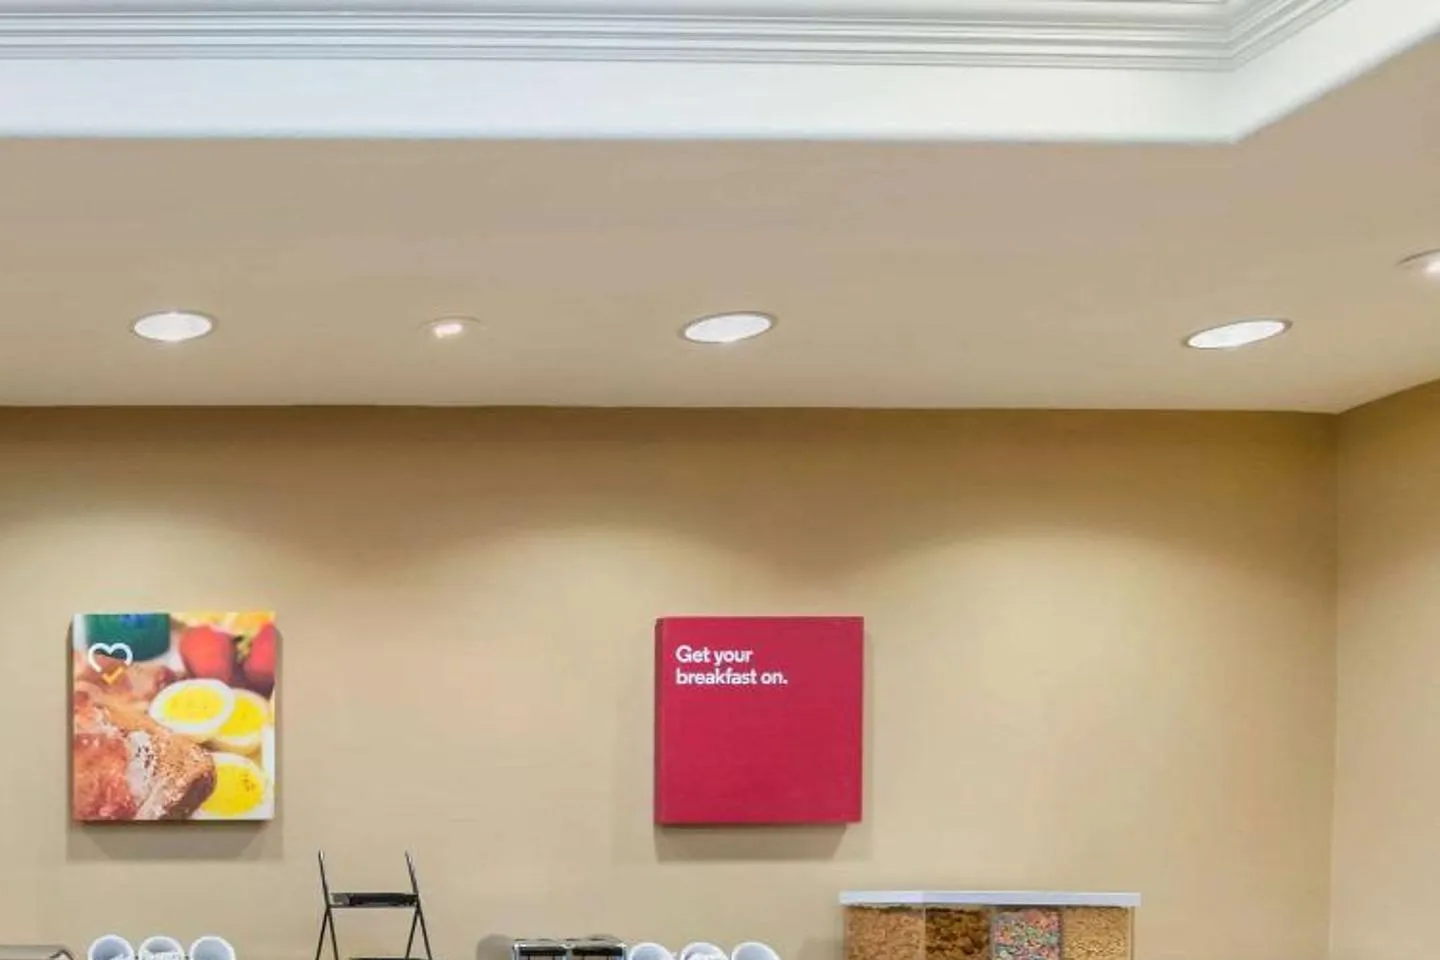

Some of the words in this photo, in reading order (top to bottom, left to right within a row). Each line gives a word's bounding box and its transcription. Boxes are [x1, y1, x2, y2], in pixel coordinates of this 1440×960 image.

[675, 644, 711, 664] Get
[714, 649, 754, 666] your
[675, 667, 758, 685] breakfast
[760, 671, 789, 685] on.
